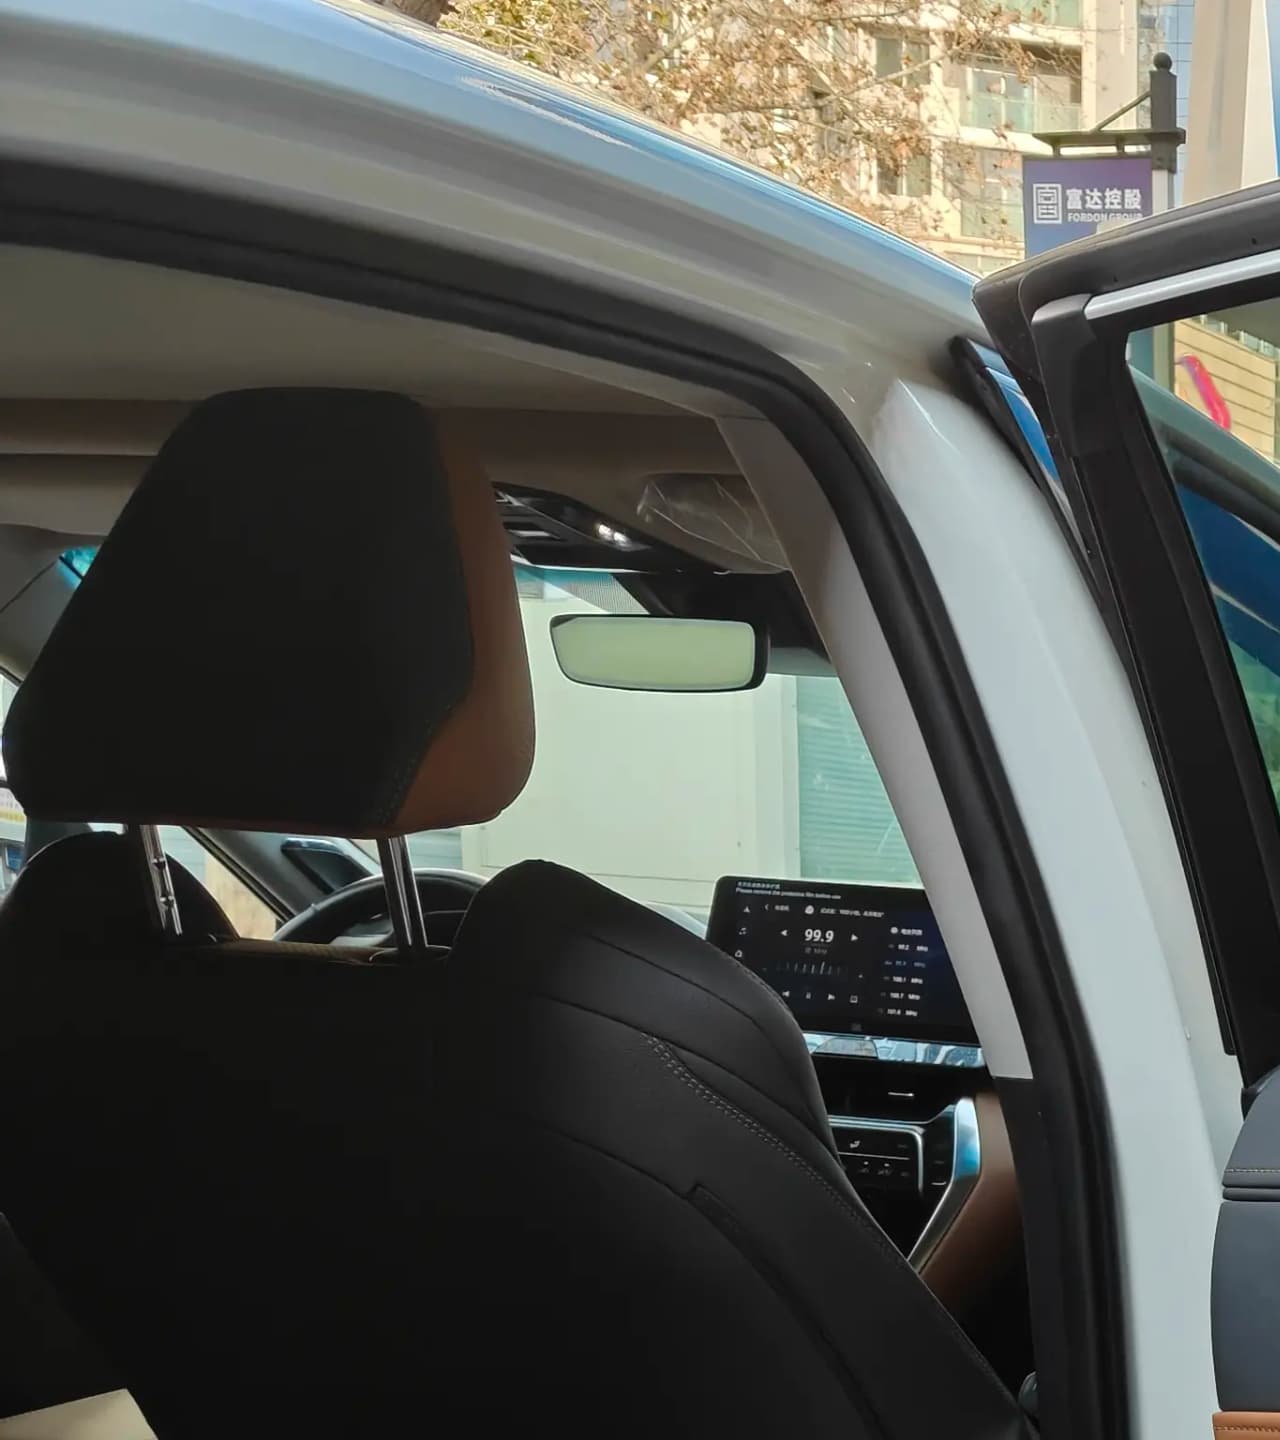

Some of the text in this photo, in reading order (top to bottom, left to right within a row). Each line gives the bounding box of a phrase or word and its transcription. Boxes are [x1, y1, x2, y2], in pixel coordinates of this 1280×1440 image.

[1066, 187, 1142, 210] 富达控股
[804, 928, 835, 943] 99.9
